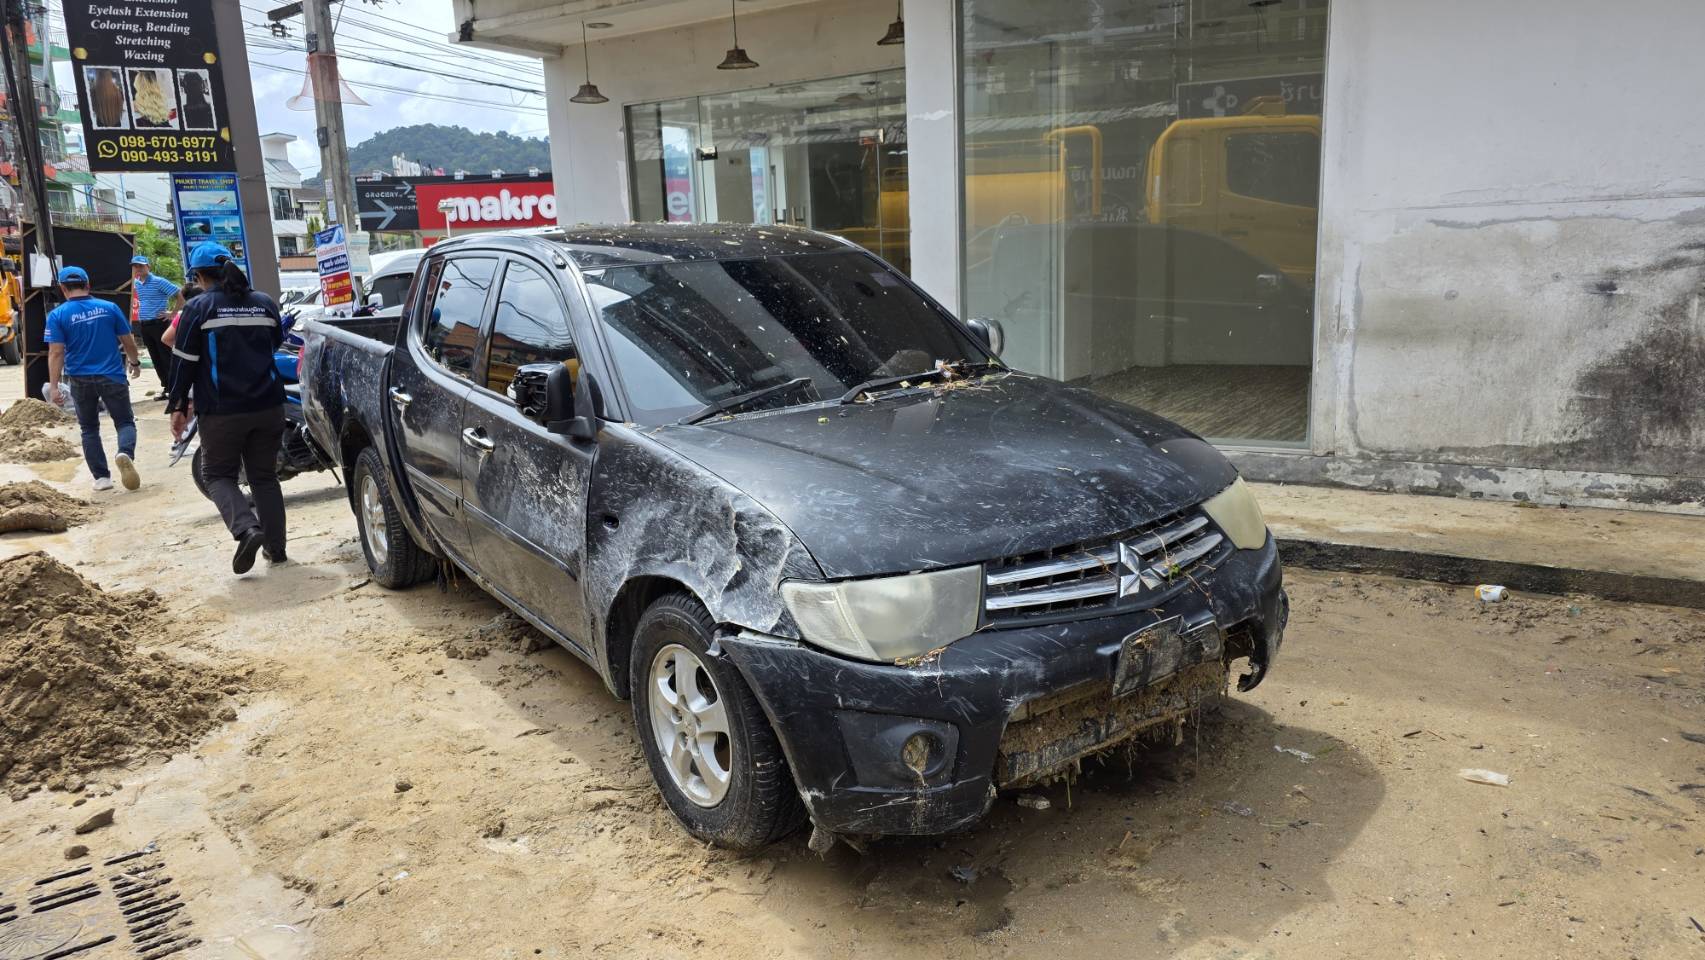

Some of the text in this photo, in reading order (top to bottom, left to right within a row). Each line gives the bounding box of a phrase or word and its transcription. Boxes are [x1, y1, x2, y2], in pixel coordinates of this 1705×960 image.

[88, 4, 189, 19] Eyelash Extension
[90, 19, 190, 36] Coloring, Bending
[115, 35, 171, 49] Stretching
[124, 49, 165, 63] Waxing
[119, 135, 216, 148] 098-670-6977
[121, 150, 218, 162] 090-493-8191
[447, 188, 558, 222] makro
